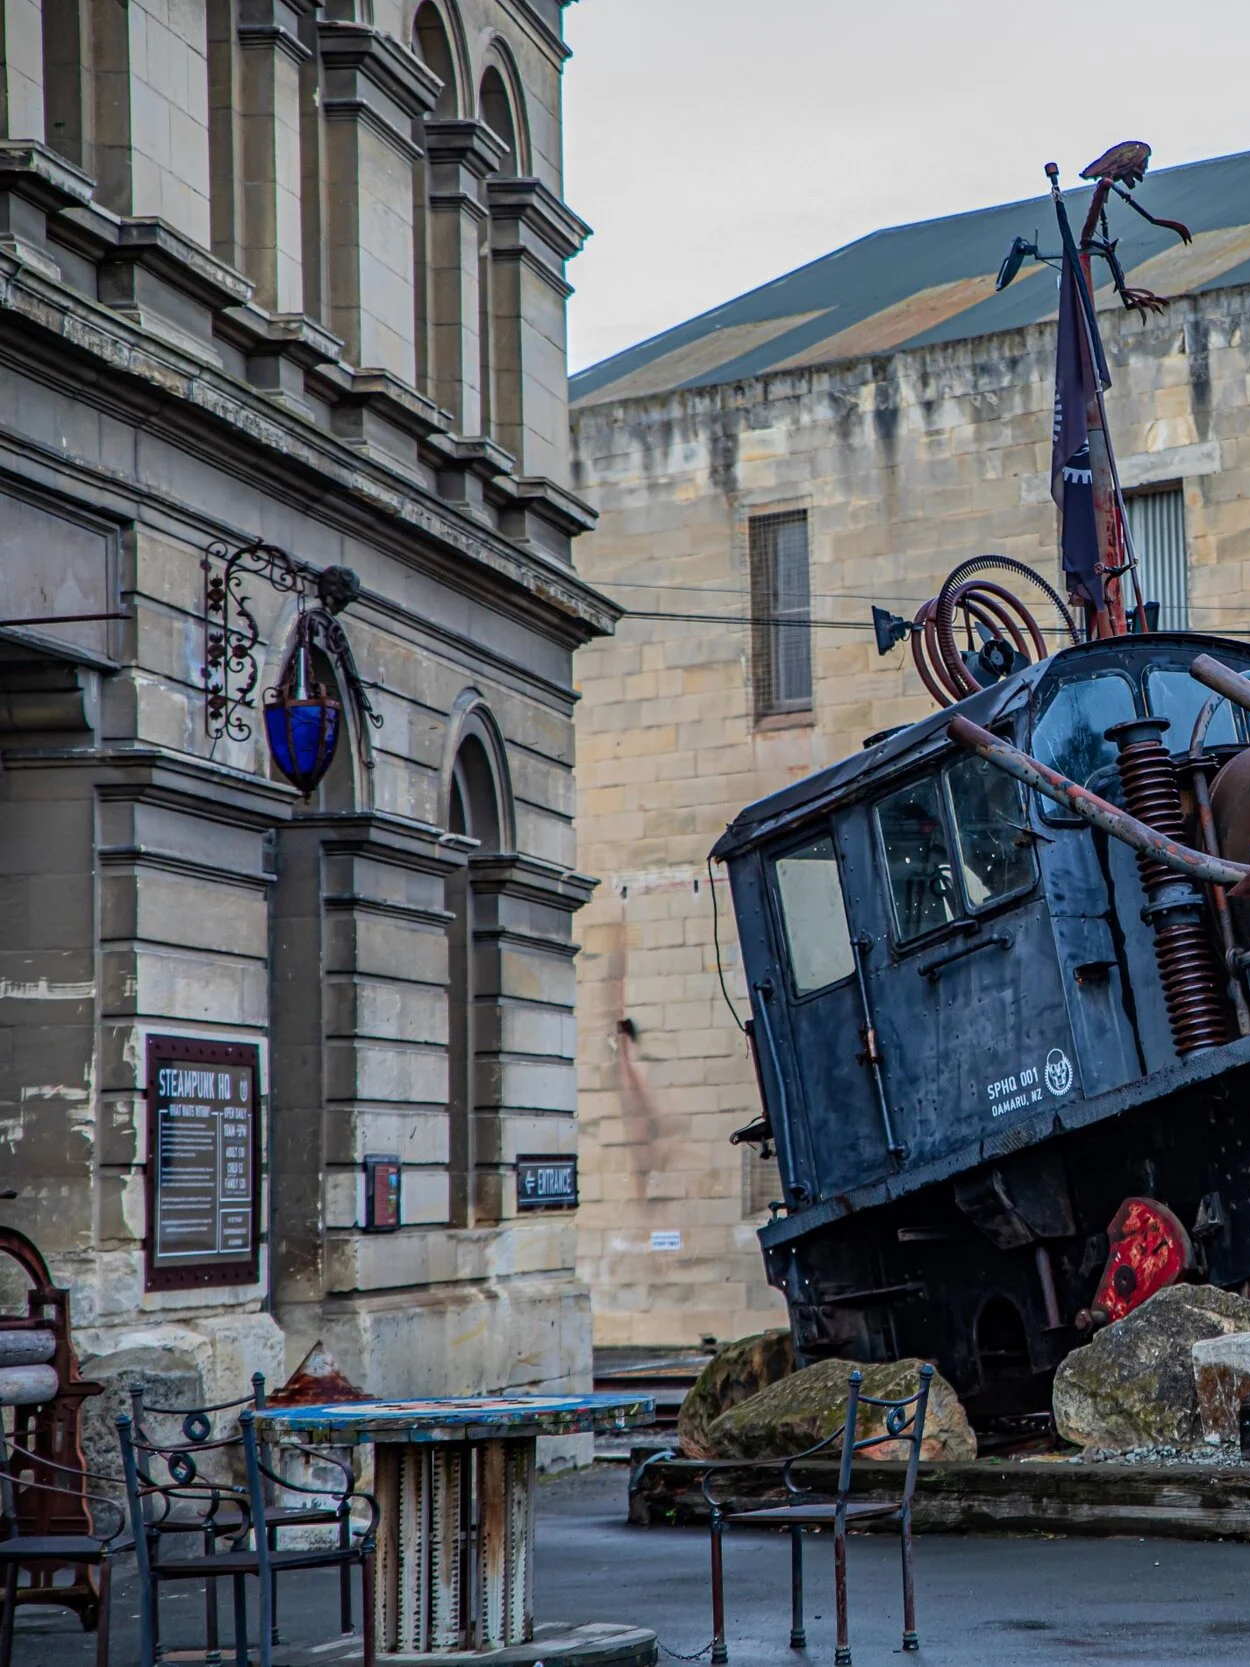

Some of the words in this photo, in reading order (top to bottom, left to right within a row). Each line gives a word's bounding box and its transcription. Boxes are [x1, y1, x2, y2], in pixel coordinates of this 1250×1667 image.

[159, 1068, 215, 1099] STEAMPUNK
[218, 1073, 231, 1099] HQ
[987, 1076, 1017, 1100] SPHQ
[1020, 1067, 1039, 1087] 001
[991, 1094, 1030, 1117] OAMARU,
[1031, 1088, 1043, 1103] NZ
[537, 1168, 571, 1195] ENTRANCE
